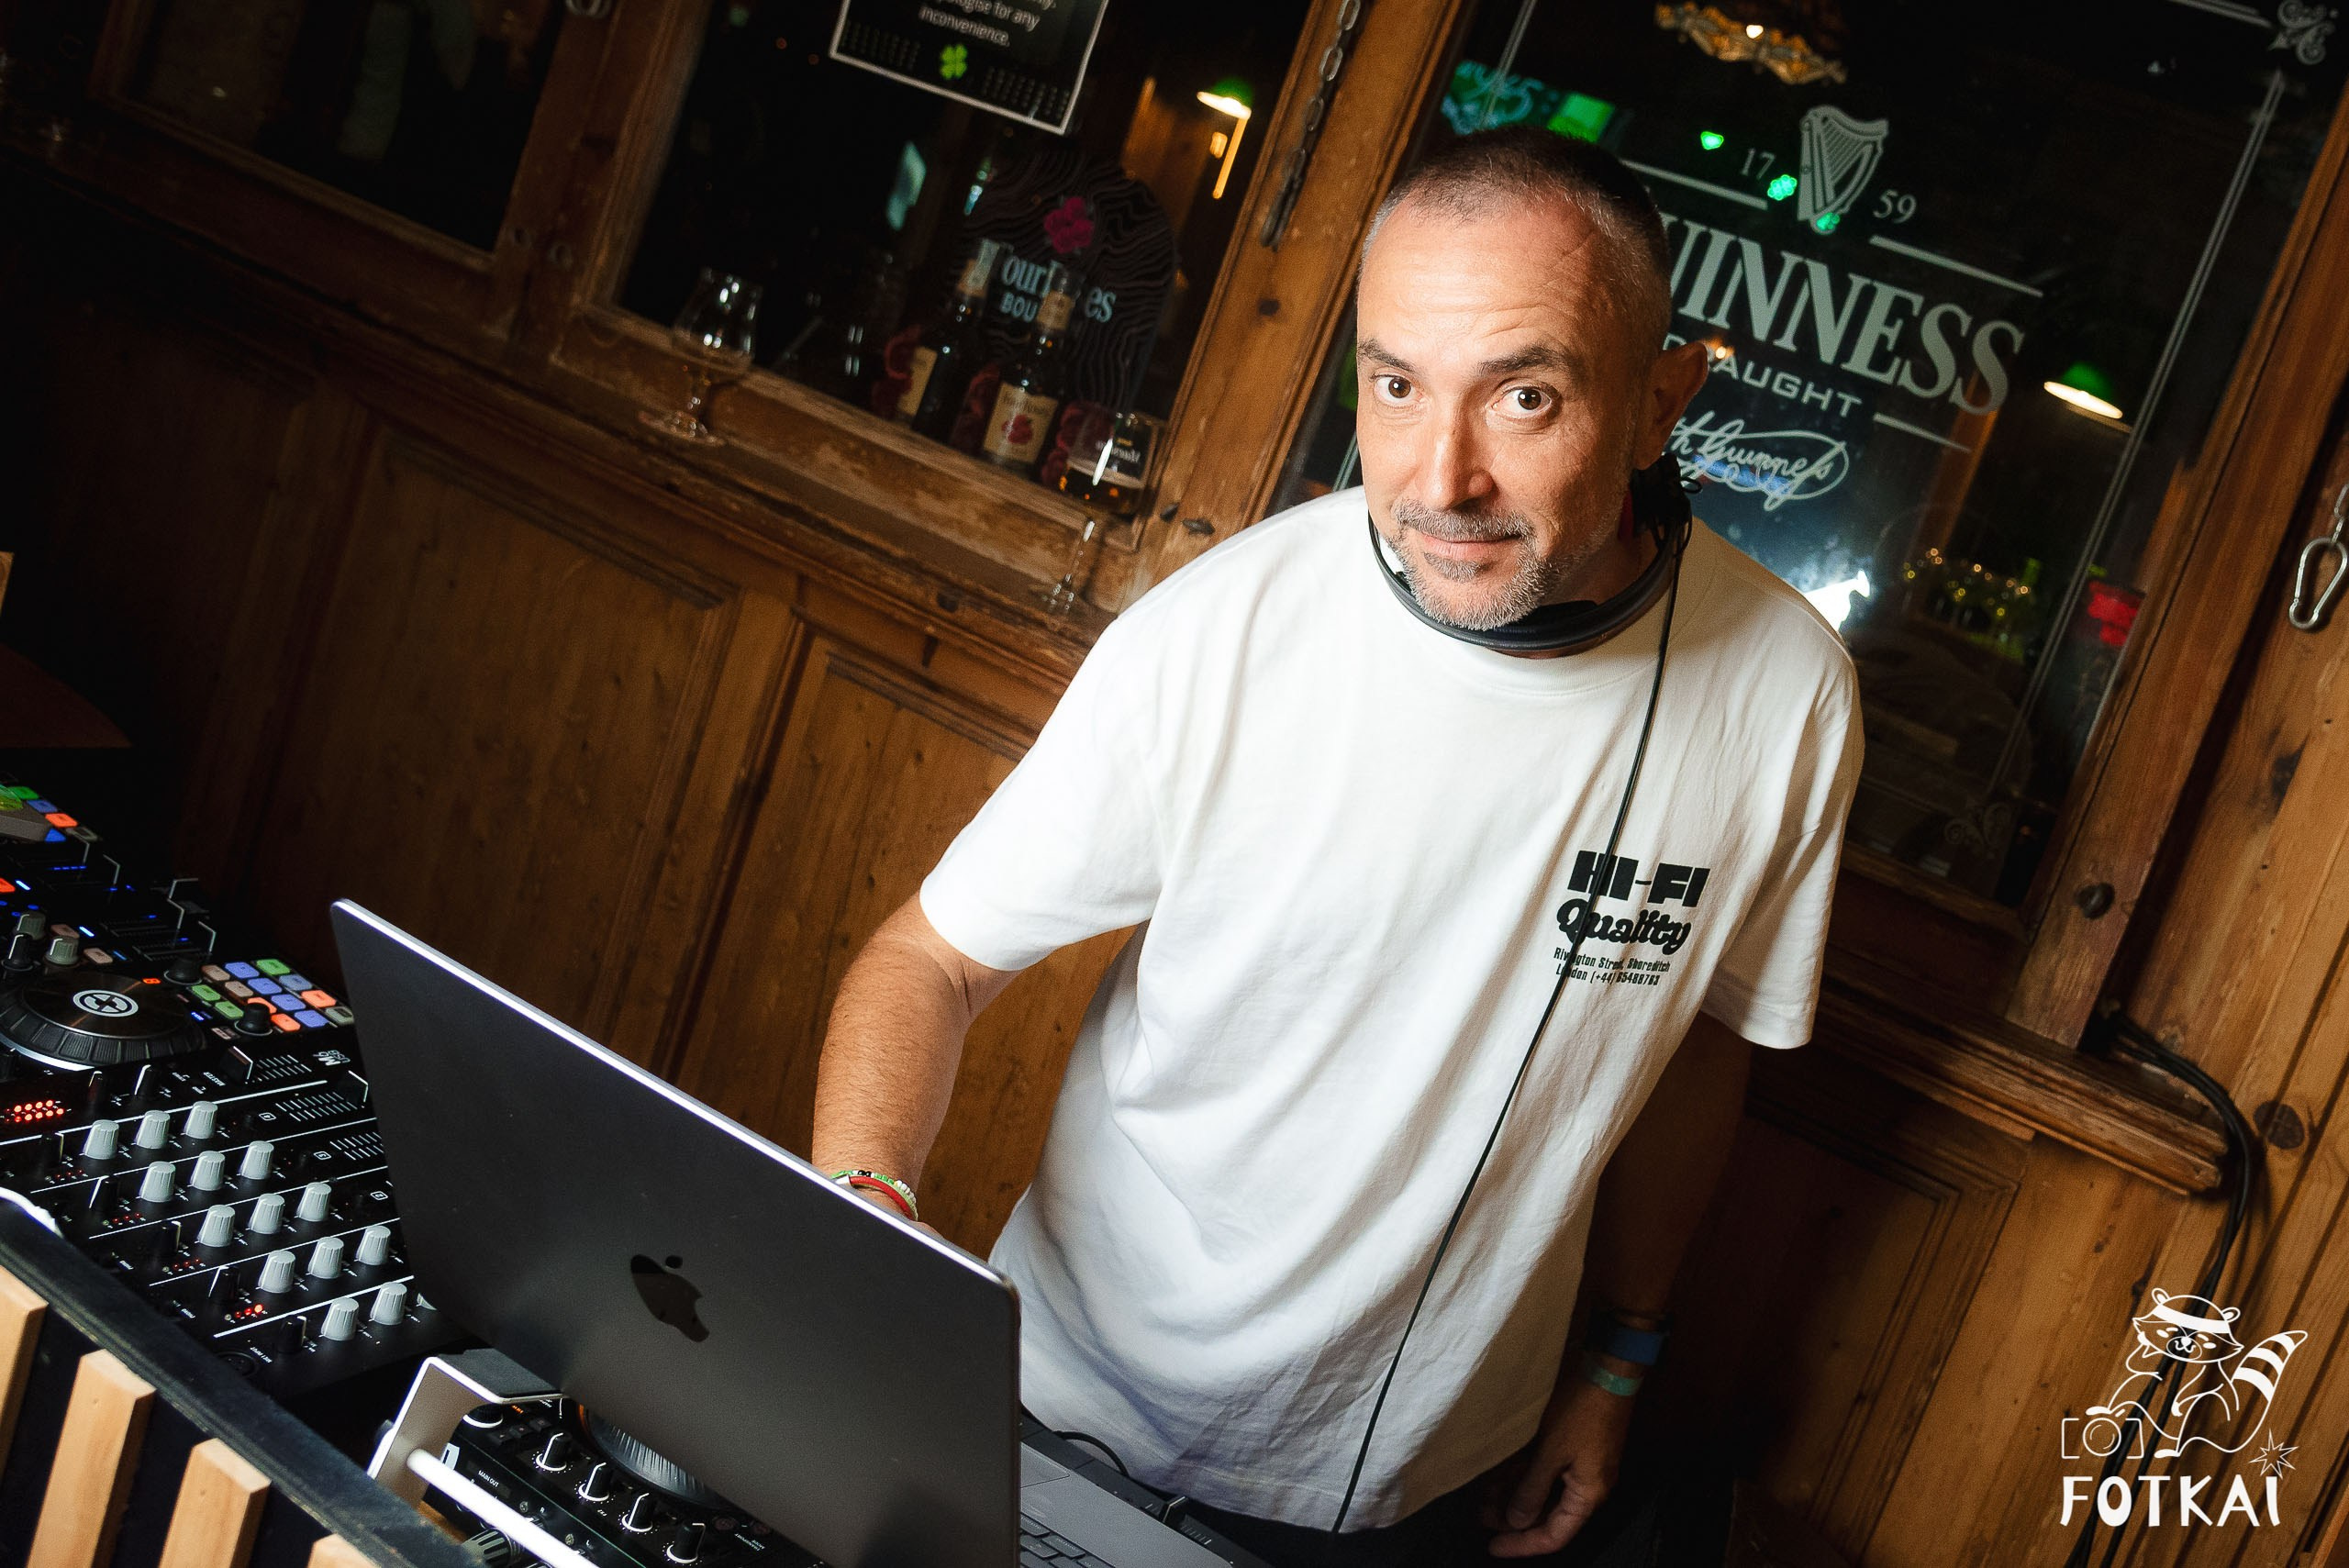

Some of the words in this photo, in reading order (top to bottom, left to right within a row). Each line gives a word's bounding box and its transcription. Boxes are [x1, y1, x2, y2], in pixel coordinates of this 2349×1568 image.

[1010, 10, 1041, 32] any
[1741, 148, 1776, 181] 17
[1873, 189, 1917, 224] 59
[1658, 212, 2024, 415] INNESS
[1567, 851, 1710, 906] HI-FI
[1556, 898, 1691, 955] Quality
[1553, 947, 1597, 966] Rivgton
[1627, 958, 1671, 973] Shoreditch
[1556, 963, 1588, 981] Ldon
